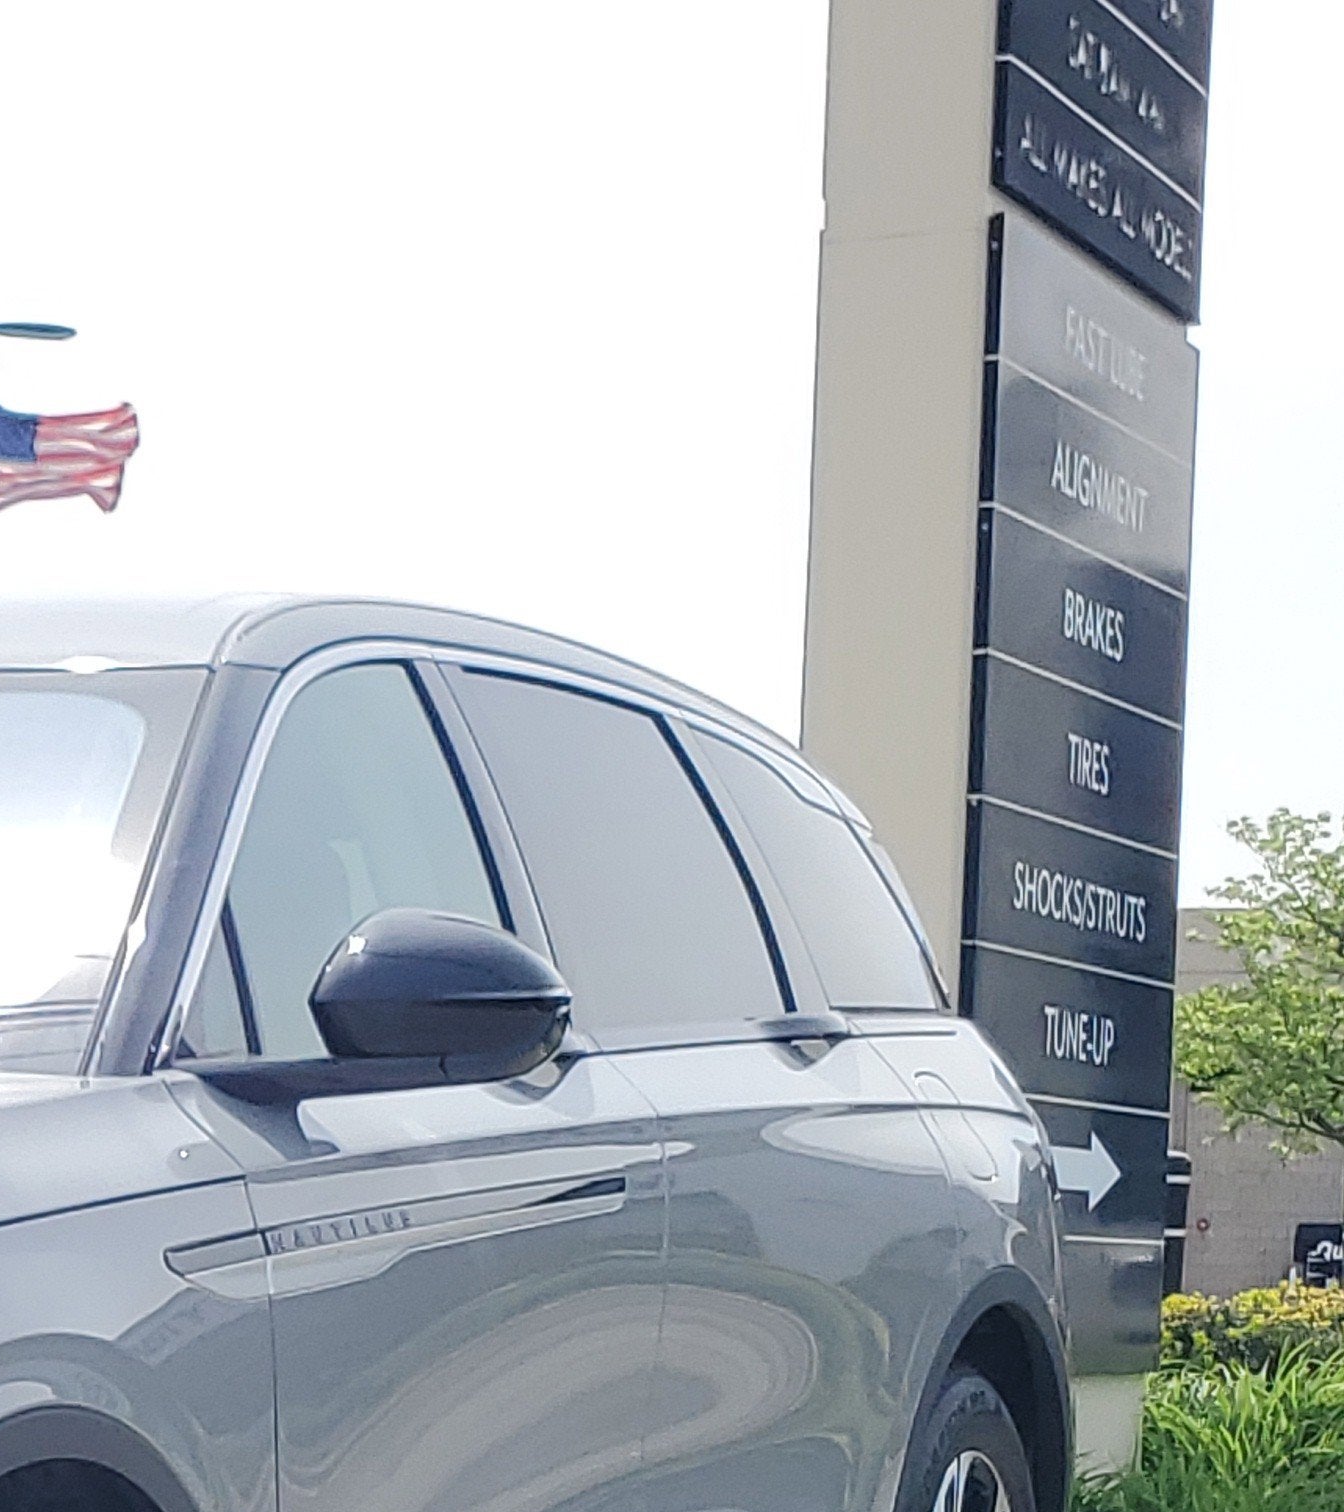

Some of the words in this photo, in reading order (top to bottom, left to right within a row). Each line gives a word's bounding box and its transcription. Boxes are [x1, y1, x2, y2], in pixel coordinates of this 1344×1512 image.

[1050, 436, 1149, 533] ALIGNMENT
[1063, 587, 1125, 663] BRAKES
[1067, 731, 1111, 796] TIRES
[1013, 860, 1147, 943] SHOCKS/STRUTS
[1043, 1004, 1115, 1068] TUNE-UP
